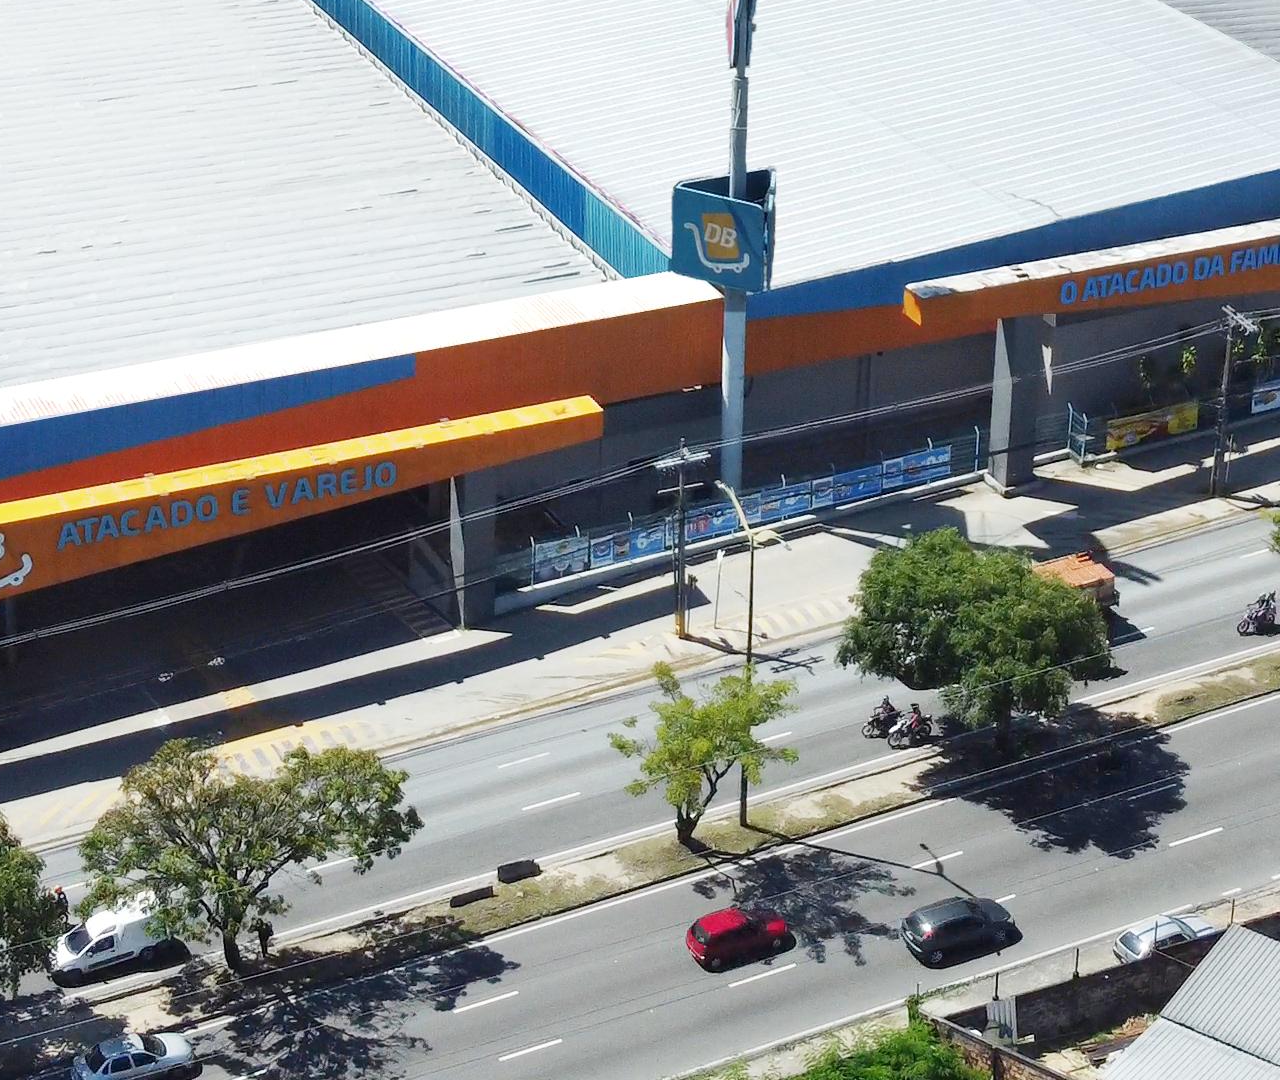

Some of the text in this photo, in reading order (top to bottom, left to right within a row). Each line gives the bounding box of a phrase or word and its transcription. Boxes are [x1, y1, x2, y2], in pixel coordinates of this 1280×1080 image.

[704, 223, 737, 248] DB
[1059, 280, 1078, 305] O
[1081, 260, 1189, 301] ATACADO
[1193, 254, 1222, 281] DA
[55, 461, 397, 552] ATACADO E VAREJO
